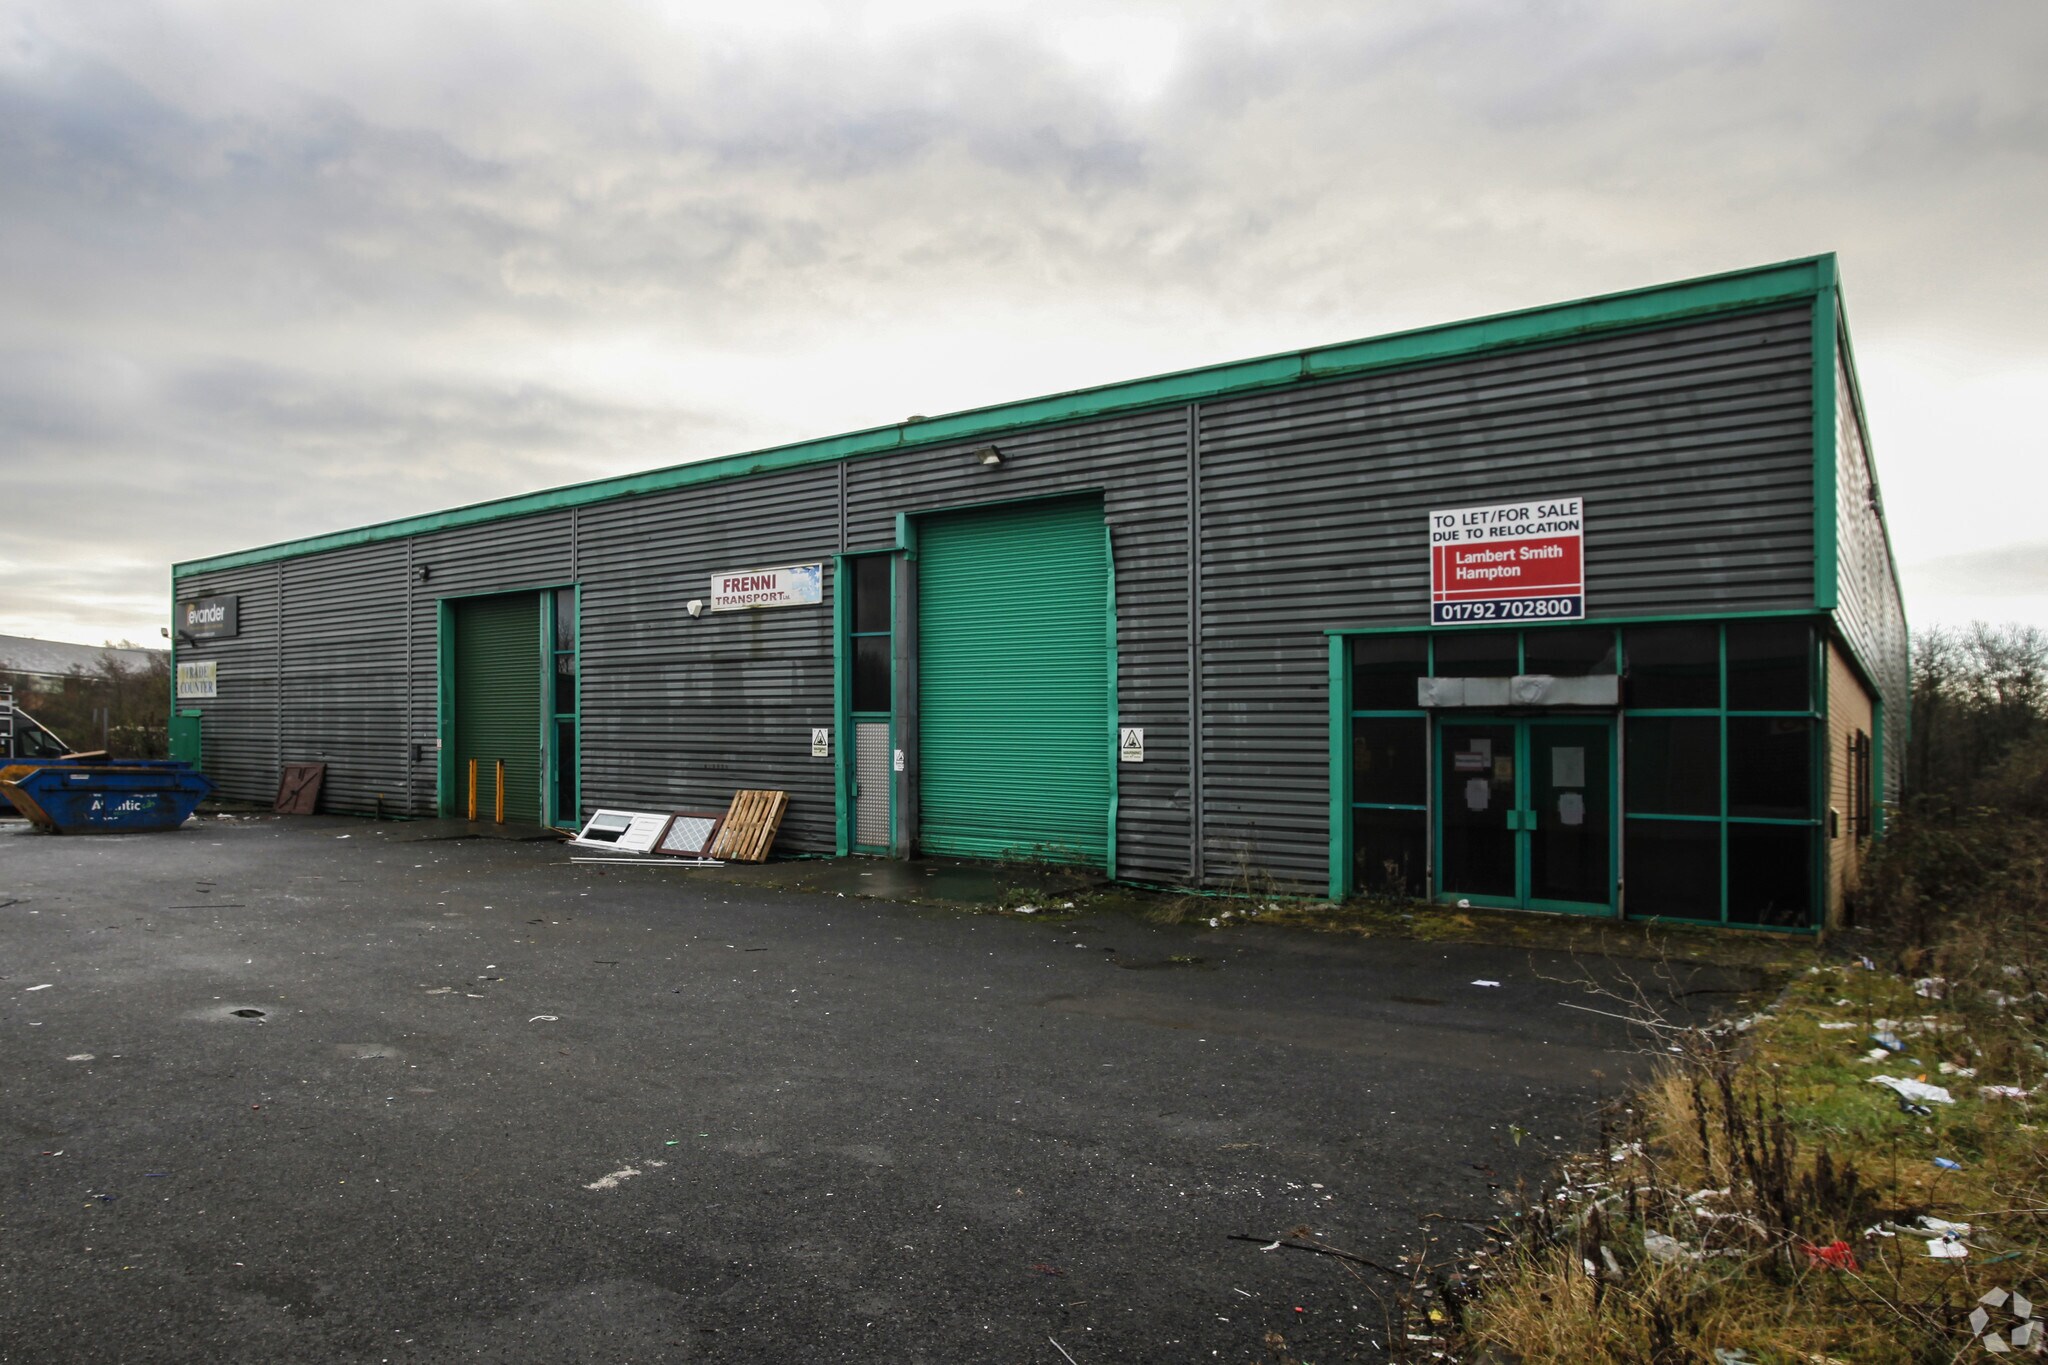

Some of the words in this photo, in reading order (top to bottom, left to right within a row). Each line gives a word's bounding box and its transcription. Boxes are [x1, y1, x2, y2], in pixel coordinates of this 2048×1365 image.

[1434, 515, 1455, 528] TO
[1462, 508, 1529, 526] LET/FOR
[1537, 502, 1578, 519] SALE
[1433, 530, 1460, 542] DUE
[1466, 529, 1483, 540] TO
[1489, 520, 1579, 537] RELOCATION
[1455, 549, 1516, 564] Lambert
[1519, 544, 1563, 561] Smith
[1456, 565, 1521, 581] Hampton
[723, 574, 776, 593] FRENNI
[716, 592, 784, 605] TRANSPORT
[189, 604, 225, 624] evander
[1441, 603, 1496, 620] 01792
[1500, 599, 1572, 617] 702800
[185, 665, 208, 679] TRADE
[180, 680, 213, 694] COUNTER
